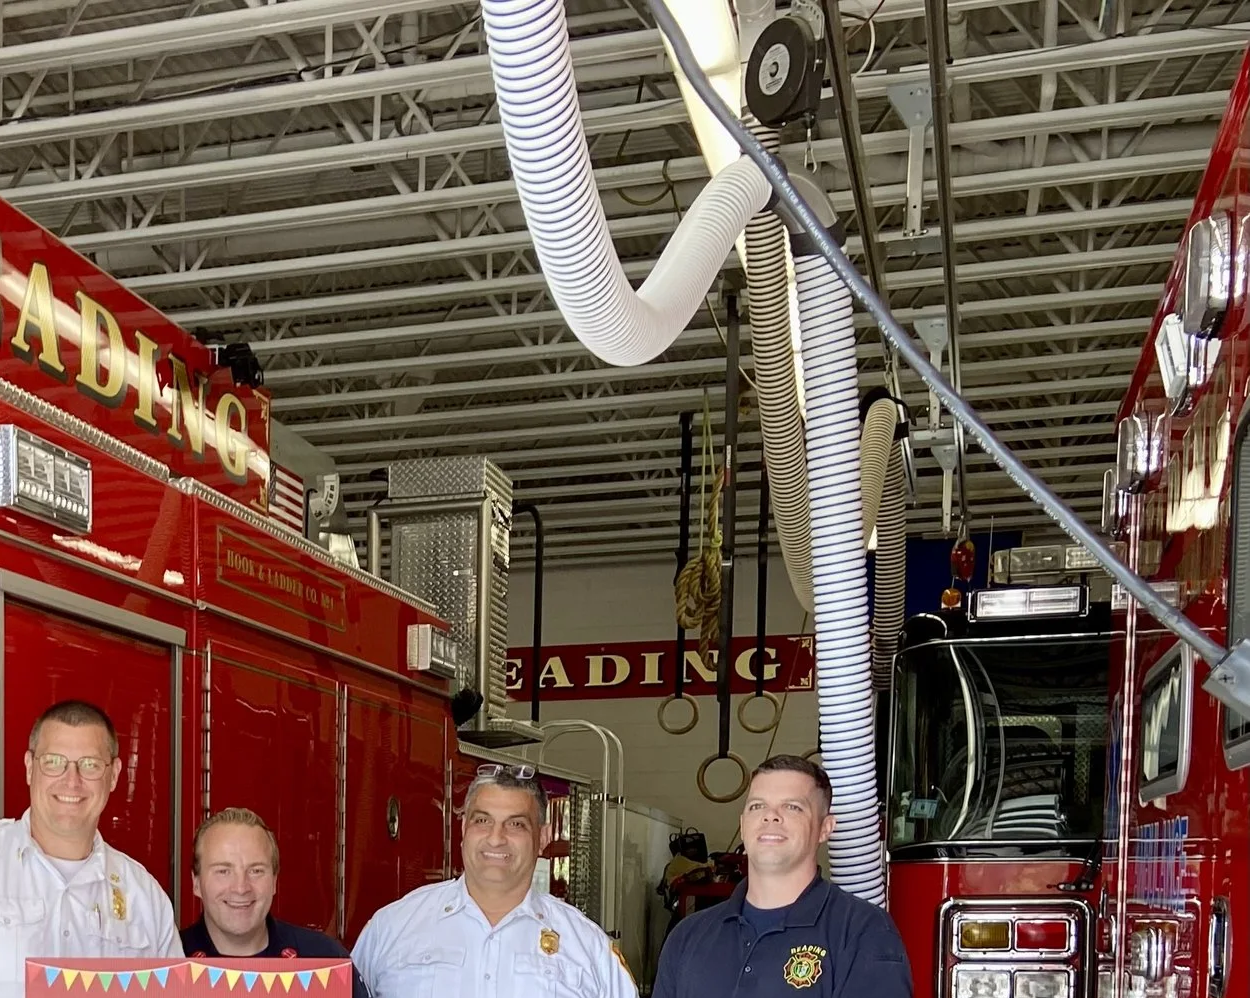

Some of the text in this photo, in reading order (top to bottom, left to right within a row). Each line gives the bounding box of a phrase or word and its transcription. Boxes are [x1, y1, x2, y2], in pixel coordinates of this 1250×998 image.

[977, 437, 991, 454] AWG
[227, 549, 255, 577] HOOK
[258, 564, 265, 581] &
[268, 567, 303, 598] LADDER
[506, 647, 781, 690] EADING
[791, 944, 826, 957] READING
